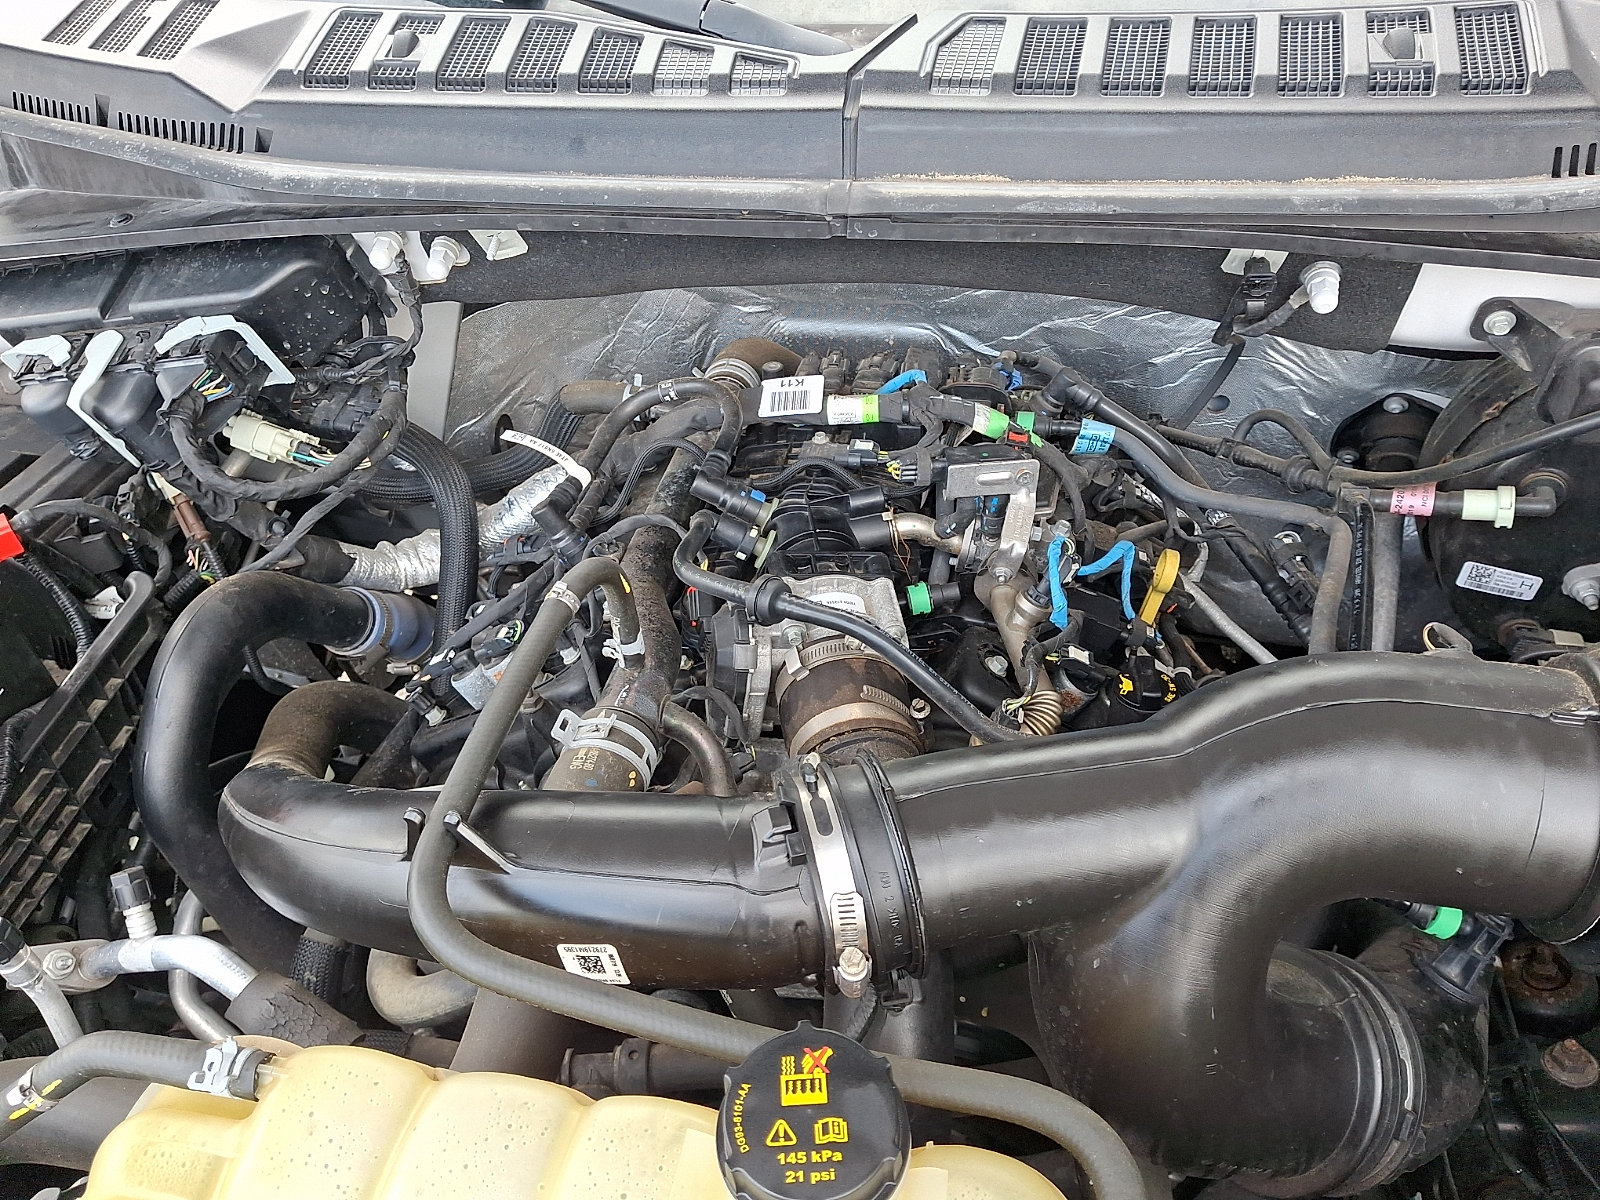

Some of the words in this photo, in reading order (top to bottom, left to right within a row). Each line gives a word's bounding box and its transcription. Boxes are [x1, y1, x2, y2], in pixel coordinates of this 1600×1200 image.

[780, 378, 805, 388] K11
[776, 1150, 807, 1165] 145
[811, 1149, 843, 1163] kPa
[785, 1170, 805, 1184] 21
[810, 1168, 836, 1185] psi
